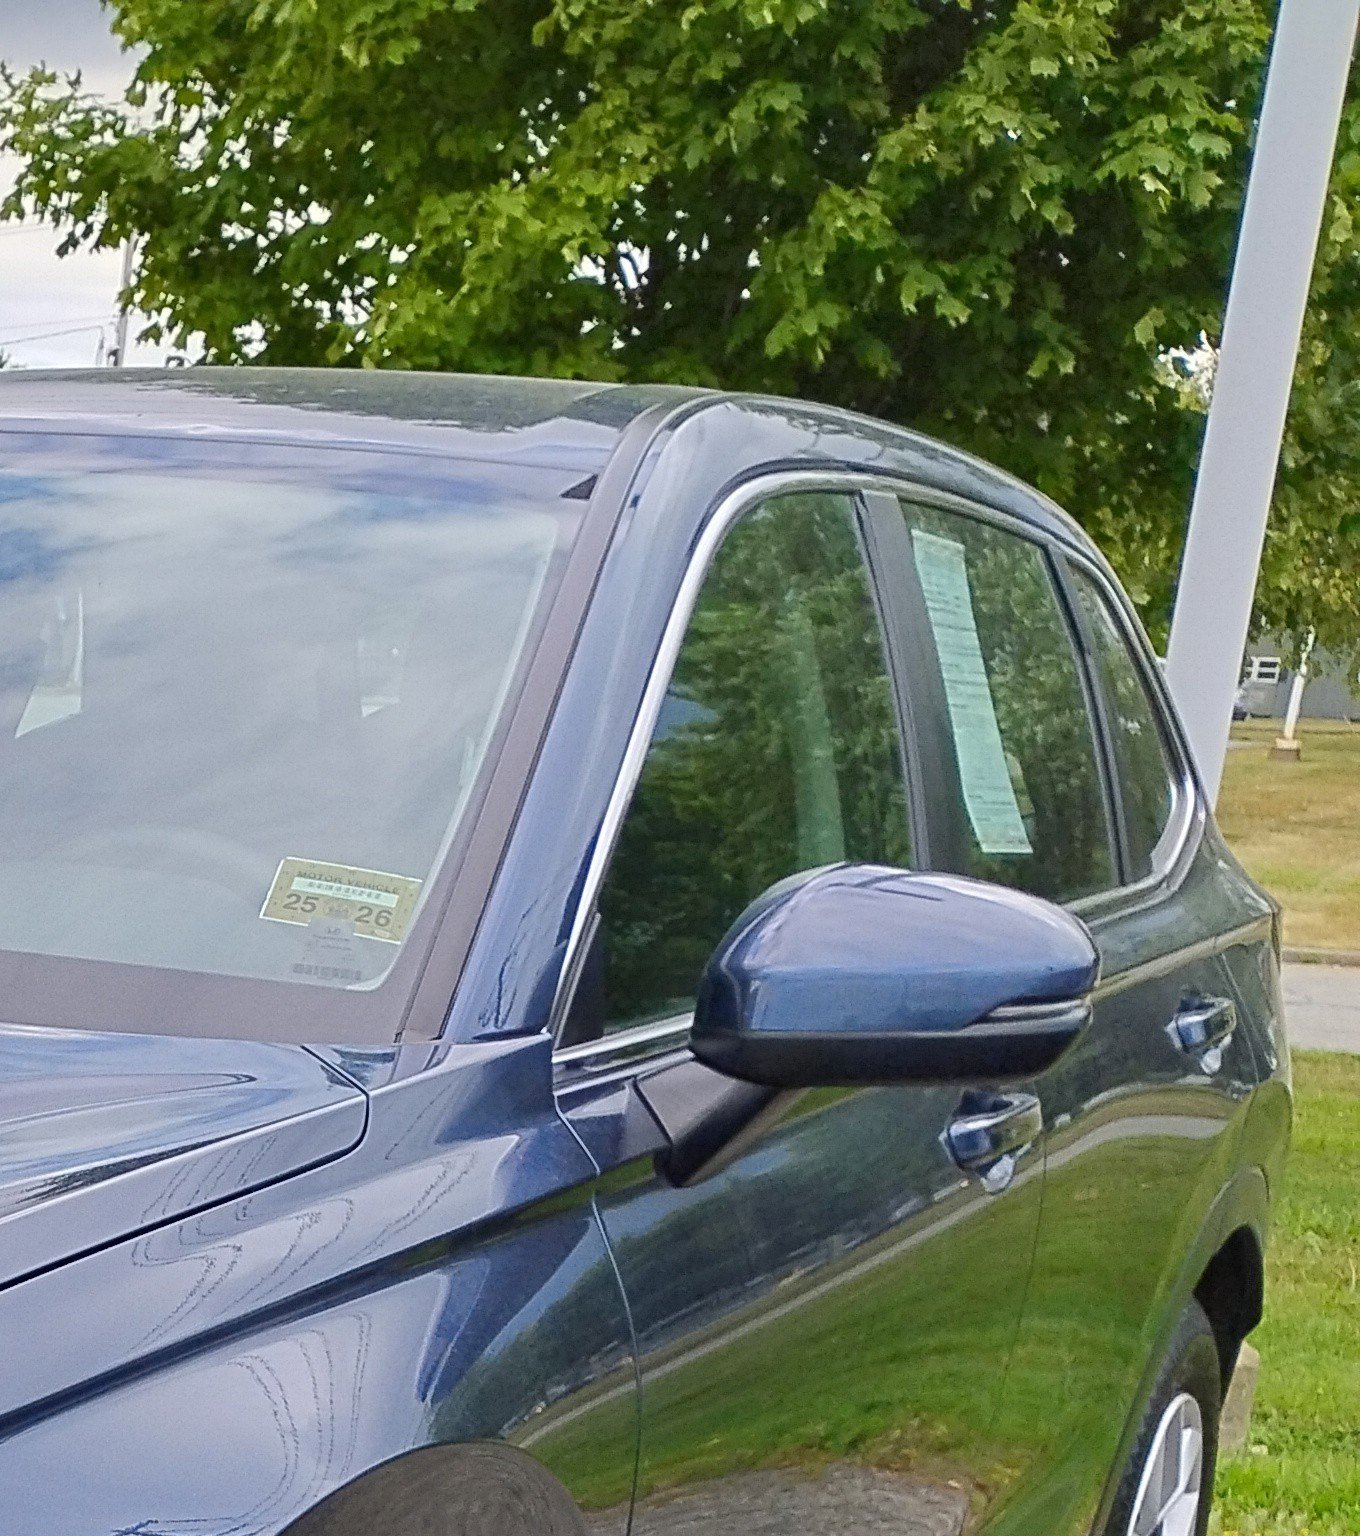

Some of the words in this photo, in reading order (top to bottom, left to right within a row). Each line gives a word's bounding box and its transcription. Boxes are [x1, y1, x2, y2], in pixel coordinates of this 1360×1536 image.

[295, 870, 344, 885] MOTOR
[347, 879, 400, 894] VEHICLE
[282, 893, 320, 914] 25
[353, 906, 394, 928] 26
